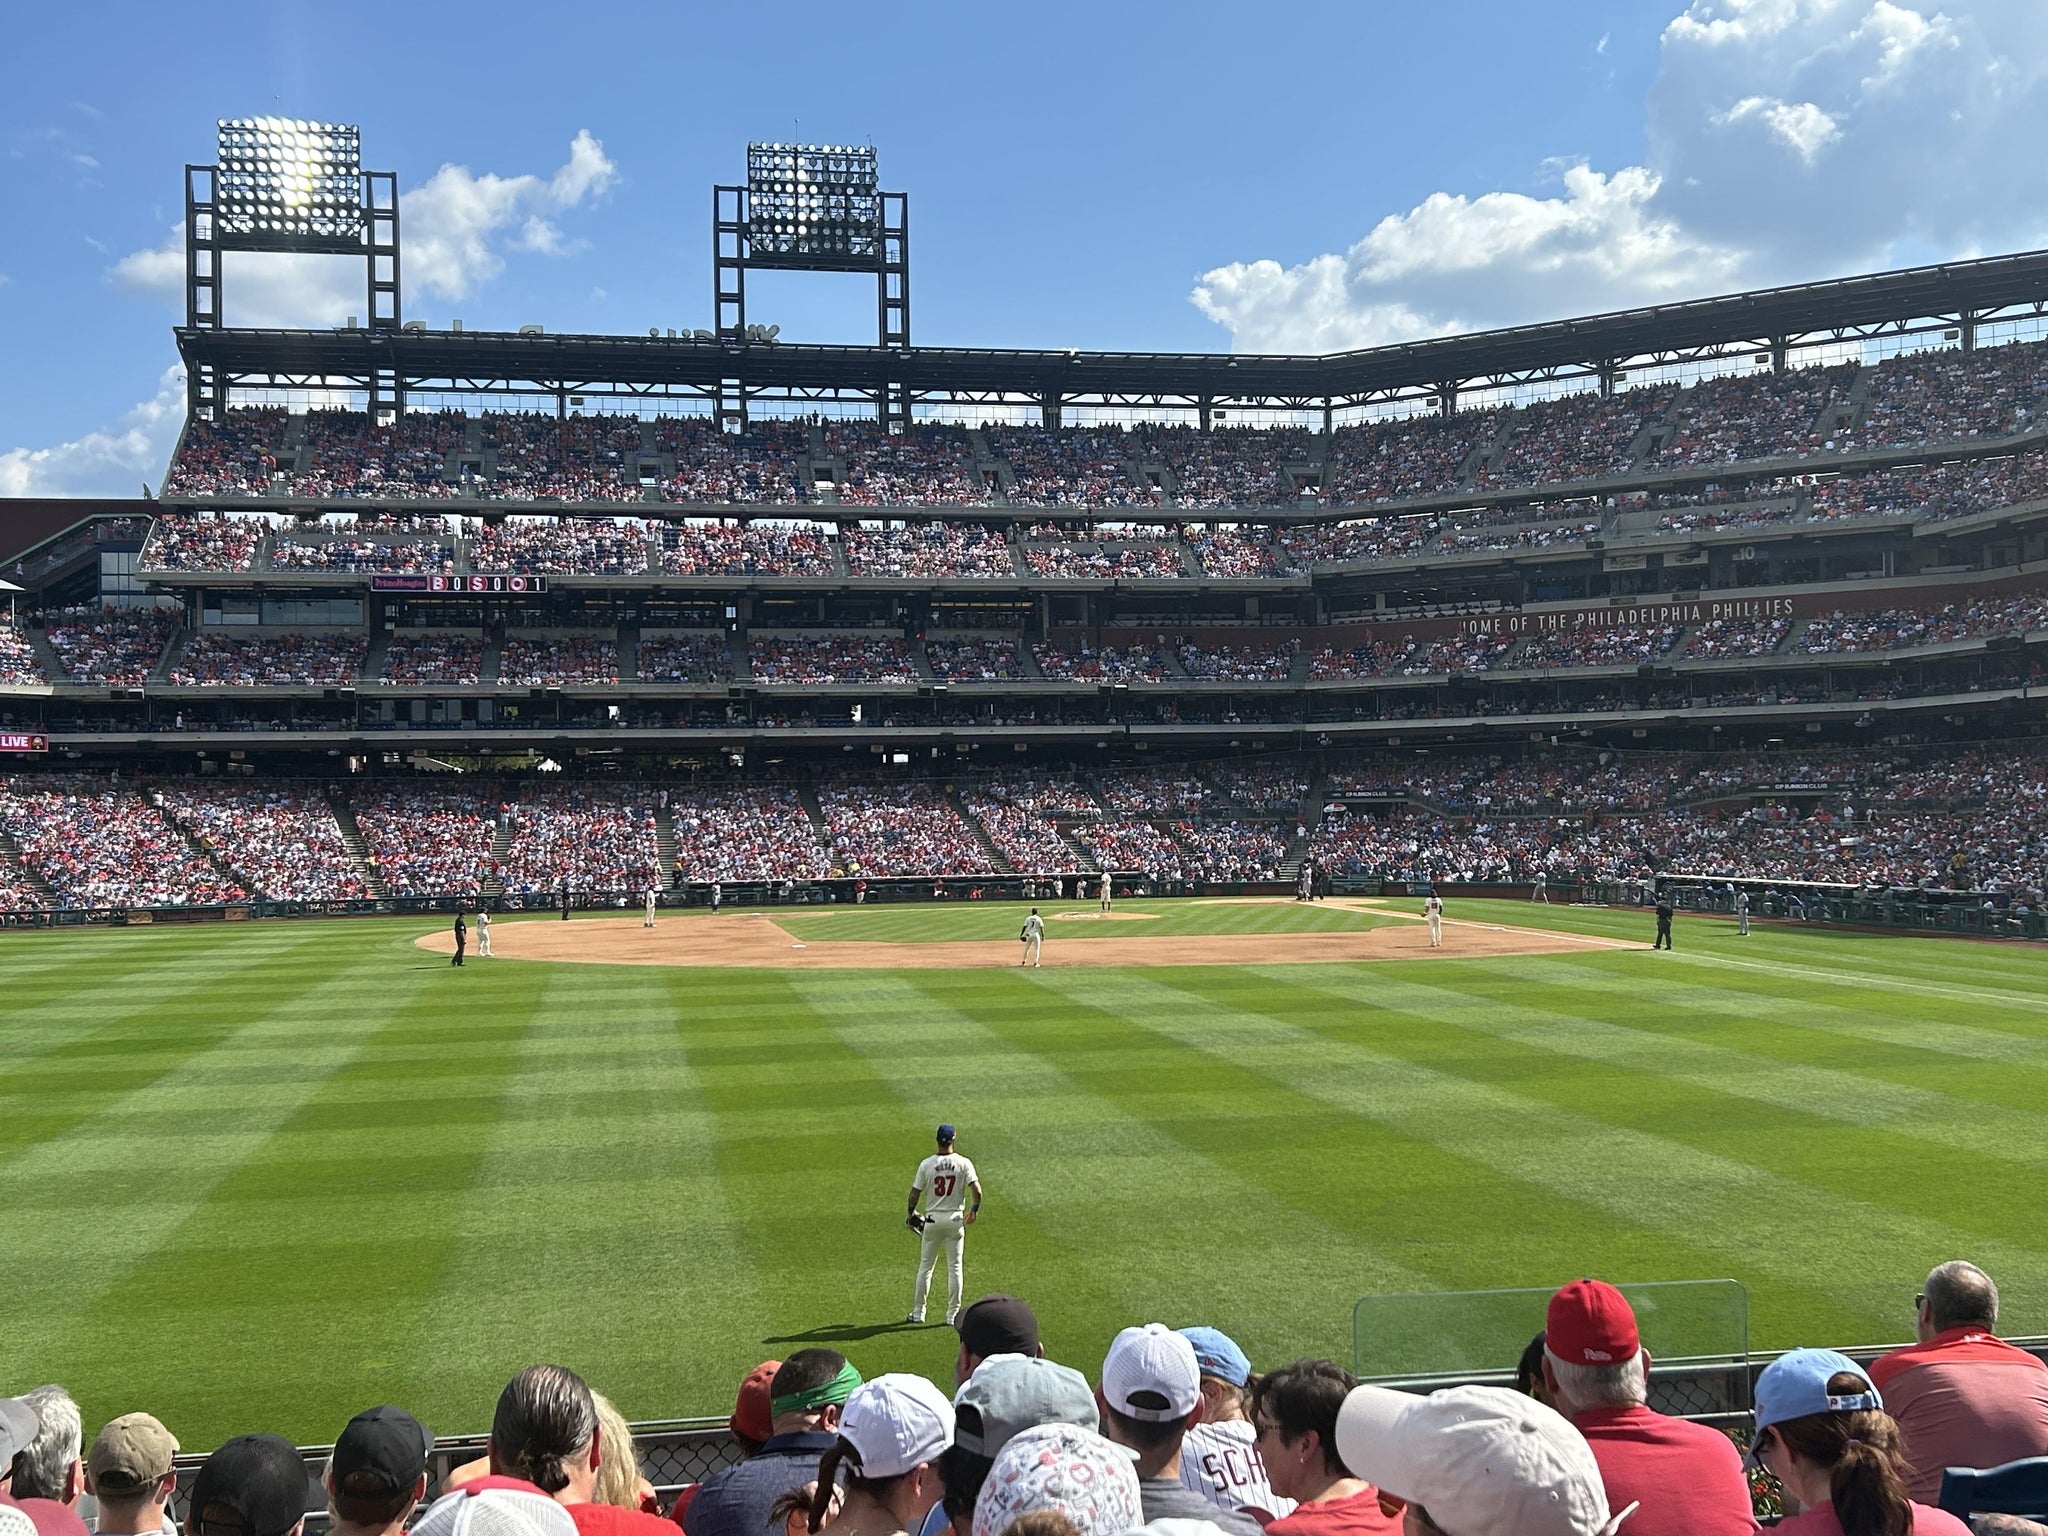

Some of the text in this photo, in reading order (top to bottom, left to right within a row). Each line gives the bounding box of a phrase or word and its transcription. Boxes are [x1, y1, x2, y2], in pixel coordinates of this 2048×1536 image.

[433, 577, 540, 591] B 0 S 0 O 1
[1510, 616, 1528, 632] OF
[1538, 614, 1567, 630] THE
[1577, 605, 1701, 626] PHILADELPHIA
[1713, 598, 1794, 618] PHILIES
[1, 736, 29, 747] LIVE
[933, 1174, 957, 1197] 37
